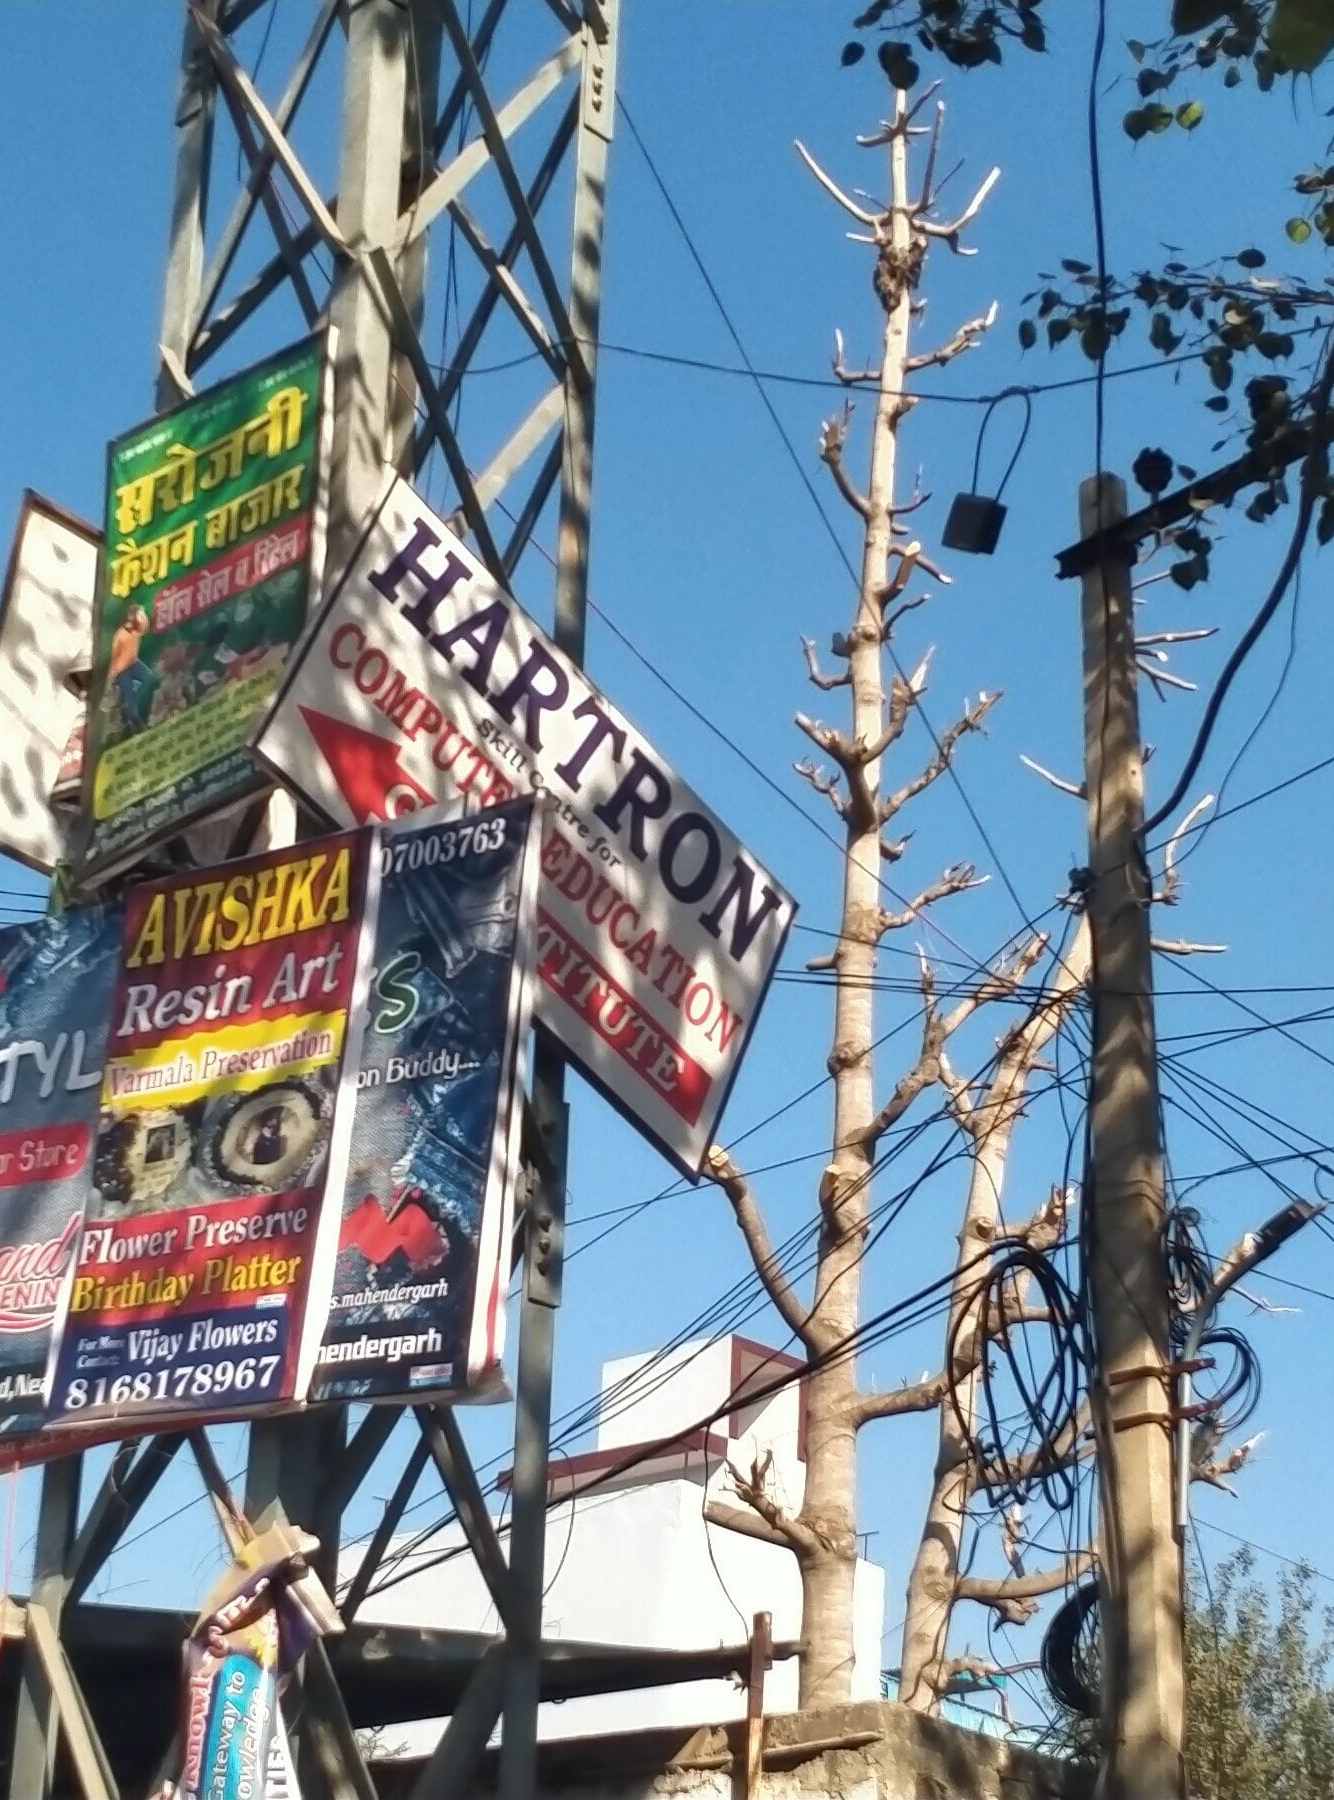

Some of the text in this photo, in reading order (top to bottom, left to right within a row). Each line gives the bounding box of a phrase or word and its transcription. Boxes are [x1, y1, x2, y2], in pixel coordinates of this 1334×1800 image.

[110, 464, 306, 599] फैशन बाजार
[367, 517, 782, 964] HARTRON
[329, 622, 743, 1054] COMPUTE EDUCATION
[586, 836, 622, 868] for
[126, 848, 351, 968] AVISHKA
[117, 941, 344, 1037] Resin Art
[535, 924, 687, 1092] TITUTE
[111, 1030, 332, 1095] Varmala Preservation
[355, 1068, 380, 1090] on
[19, 1140, 80, 1172] Store
[79, 1206, 308, 1266] Flower Preserve
[70, 1254, 302, 1313] Birthday Platter
[330, 1277, 449, 1309] s.mahendergarh
[128, 1317, 279, 1367] Vijay Flowers
[64, 1354, 281, 1410] 8168178967
[224, 1670, 247, 1696] to
[236, 1685, 271, 1800] owledge
